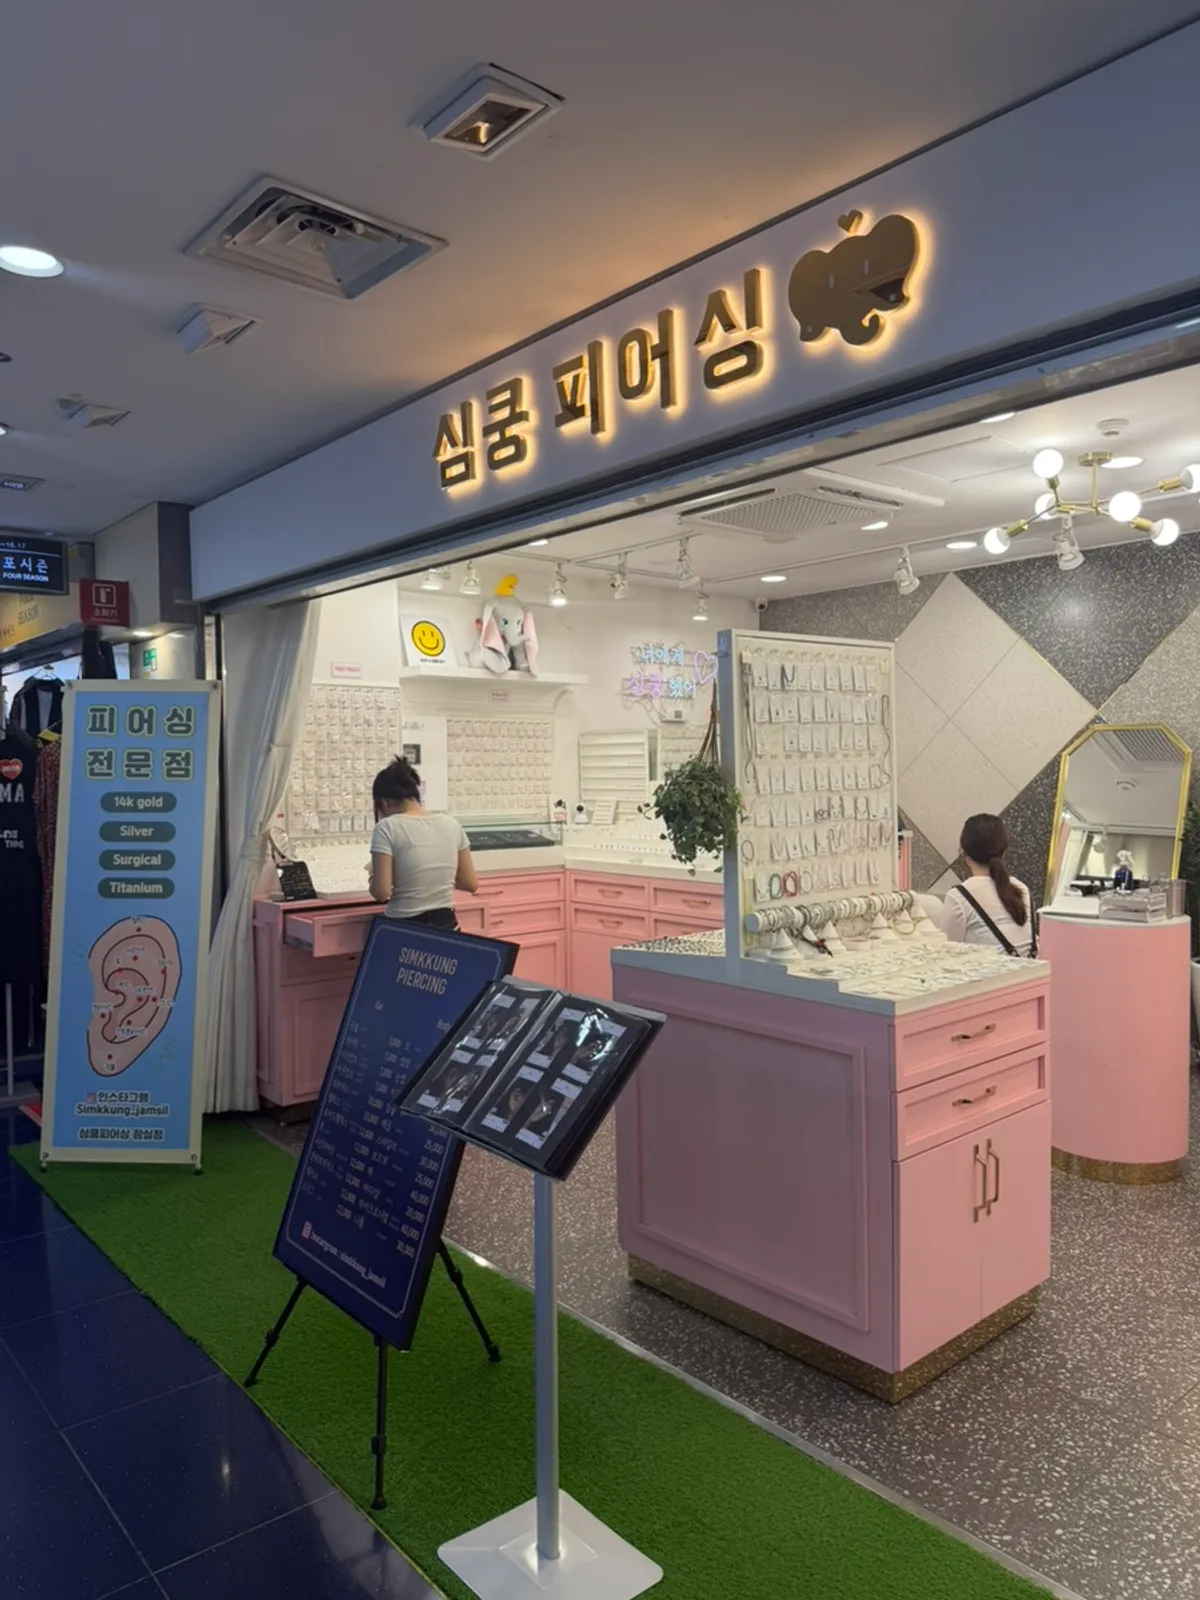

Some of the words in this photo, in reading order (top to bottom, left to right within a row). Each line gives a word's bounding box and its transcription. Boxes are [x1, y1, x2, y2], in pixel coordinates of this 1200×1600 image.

[432, 377, 529, 490] 심쿵
[552, 268, 764, 436] 피어싱
[3, 556, 49, 574] 포시즌
[3, 572, 23, 580] FOUR
[23, 573, 50, 582] SEASON
[86, 704, 195, 737] 피어싱
[85, 748, 193, 780] 전문점
[113, 796, 134, 808] 14k
[137, 796, 163, 811] gold
[120, 825, 154, 837] Silver
[113, 853, 162, 869] Surgical
[109, 881, 163, 894] Titanium
[398, 947, 458, 976] SIMKKUNG
[396, 967, 448, 995] PIERCING
[97, 1091, 149, 1103] 인스타그램
[76, 1102, 169, 1117] Simkkung_jamsil
